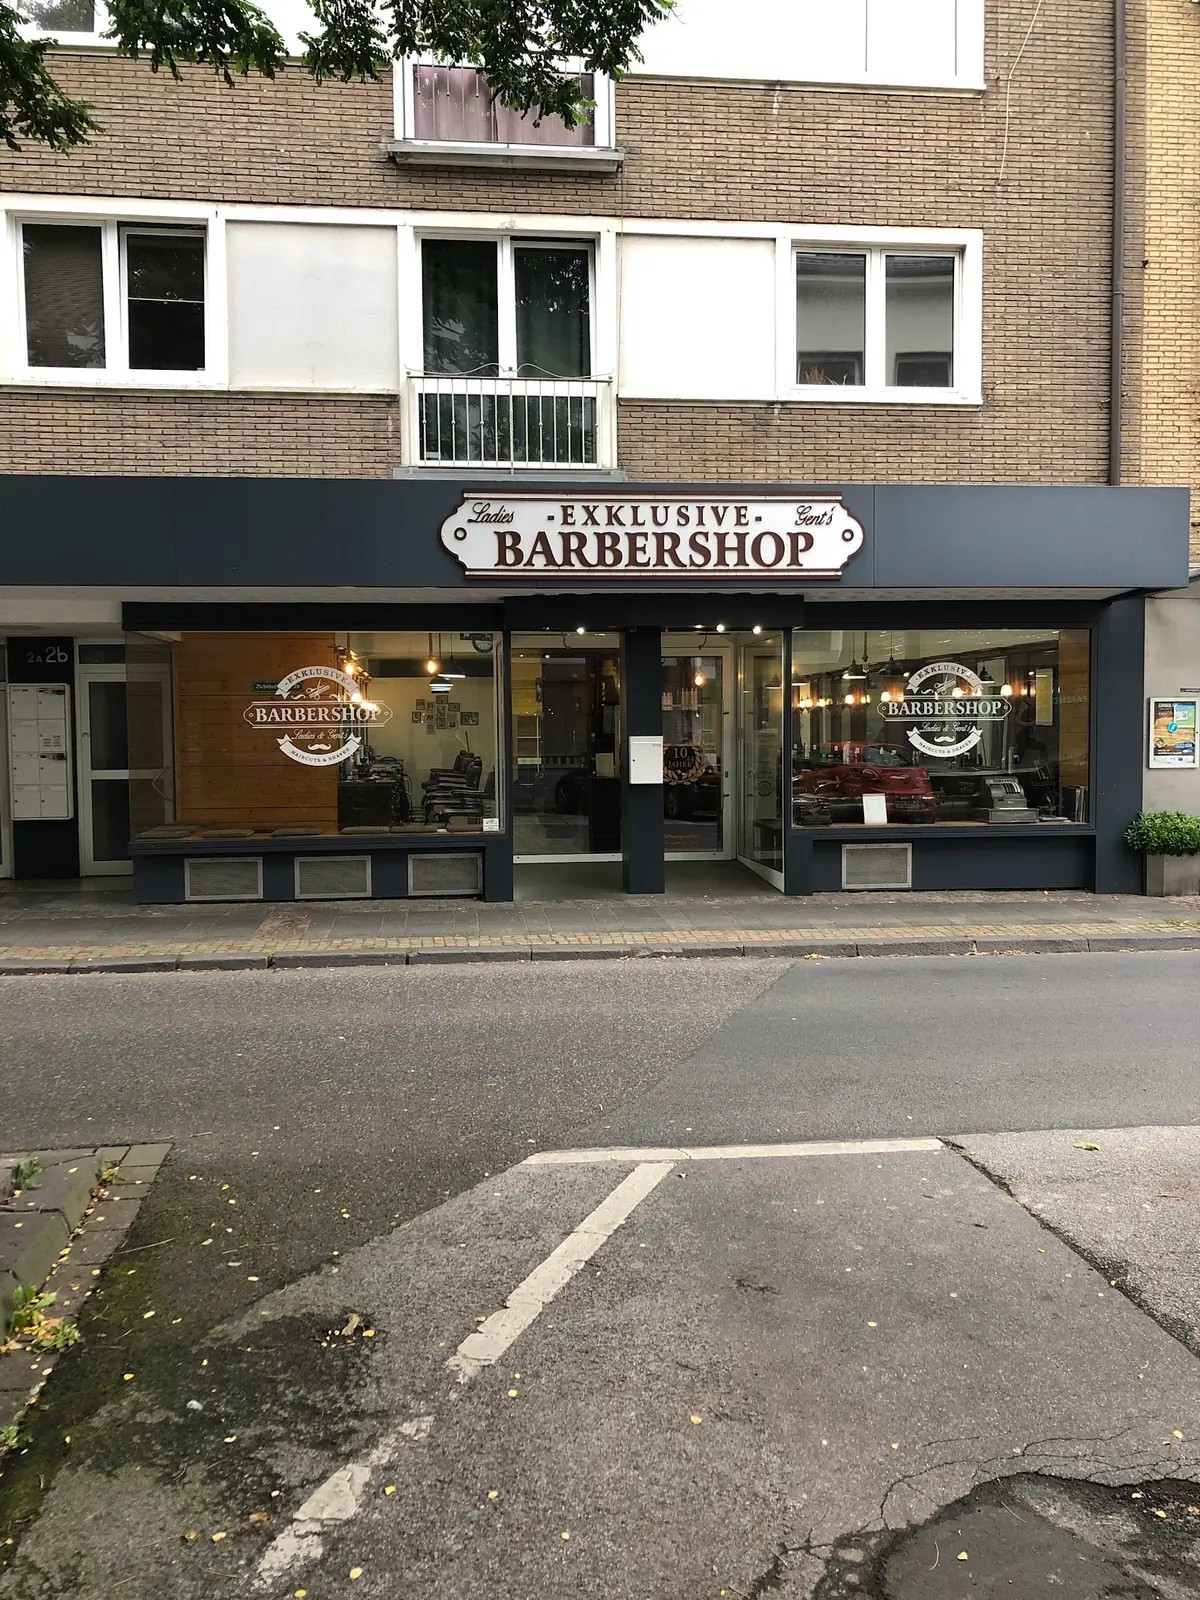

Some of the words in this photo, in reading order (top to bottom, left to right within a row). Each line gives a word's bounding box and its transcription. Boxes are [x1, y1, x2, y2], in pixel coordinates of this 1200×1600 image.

[467, 502, 516, 525] Ladies
[794, 505, 836, 527] Gent's
[494, 530, 814, 568] BARBERSHOP
[45, 646, 69, 663] 2b
[255, 706, 382, 722] BARBERSHOP
[888, 701, 1002, 716] BARBERSHOP
[673, 746, 688, 759] 10
